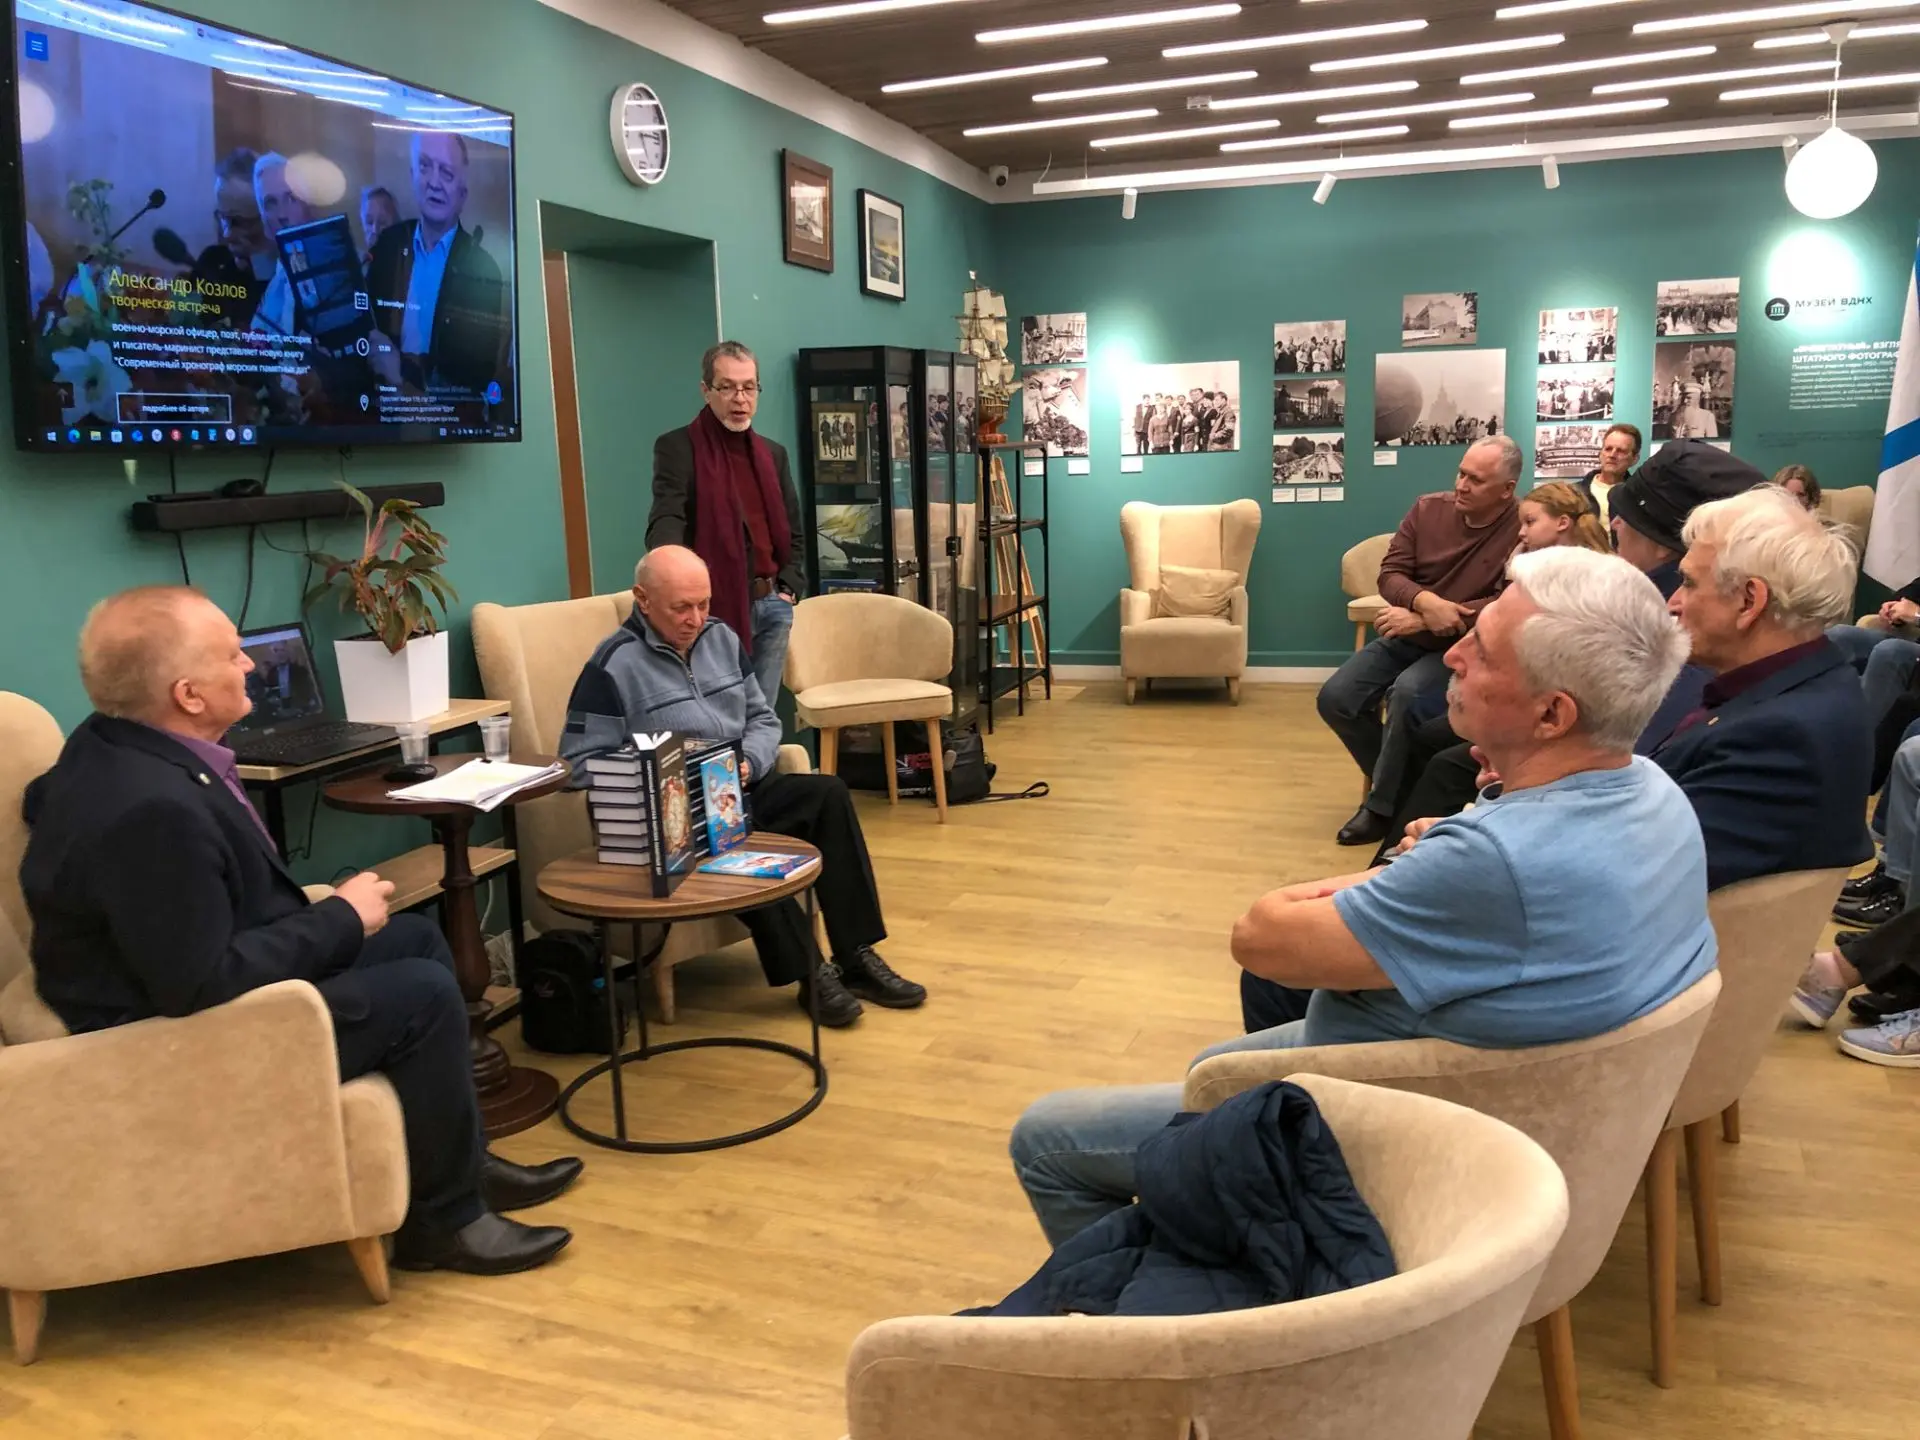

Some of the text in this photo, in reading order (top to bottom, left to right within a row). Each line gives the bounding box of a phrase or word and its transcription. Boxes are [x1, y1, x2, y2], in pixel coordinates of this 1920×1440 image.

[109, 269, 247, 299] Александр Козлов
[111, 295, 221, 315] творческая встреча
[1840, 296, 1873, 306] ВДНХ
[112, 322, 184, 337] военно-морской
[113, 341, 119, 349] и
[122, 340, 204, 355] писатель-маринист
[1873, 340, 1901, 350] ВЗГЛЯ
[115, 356, 180, 370] "Современный
[182, 360, 225, 373] хронограф
[1792, 353, 1846, 363] ШТАТНОГО
